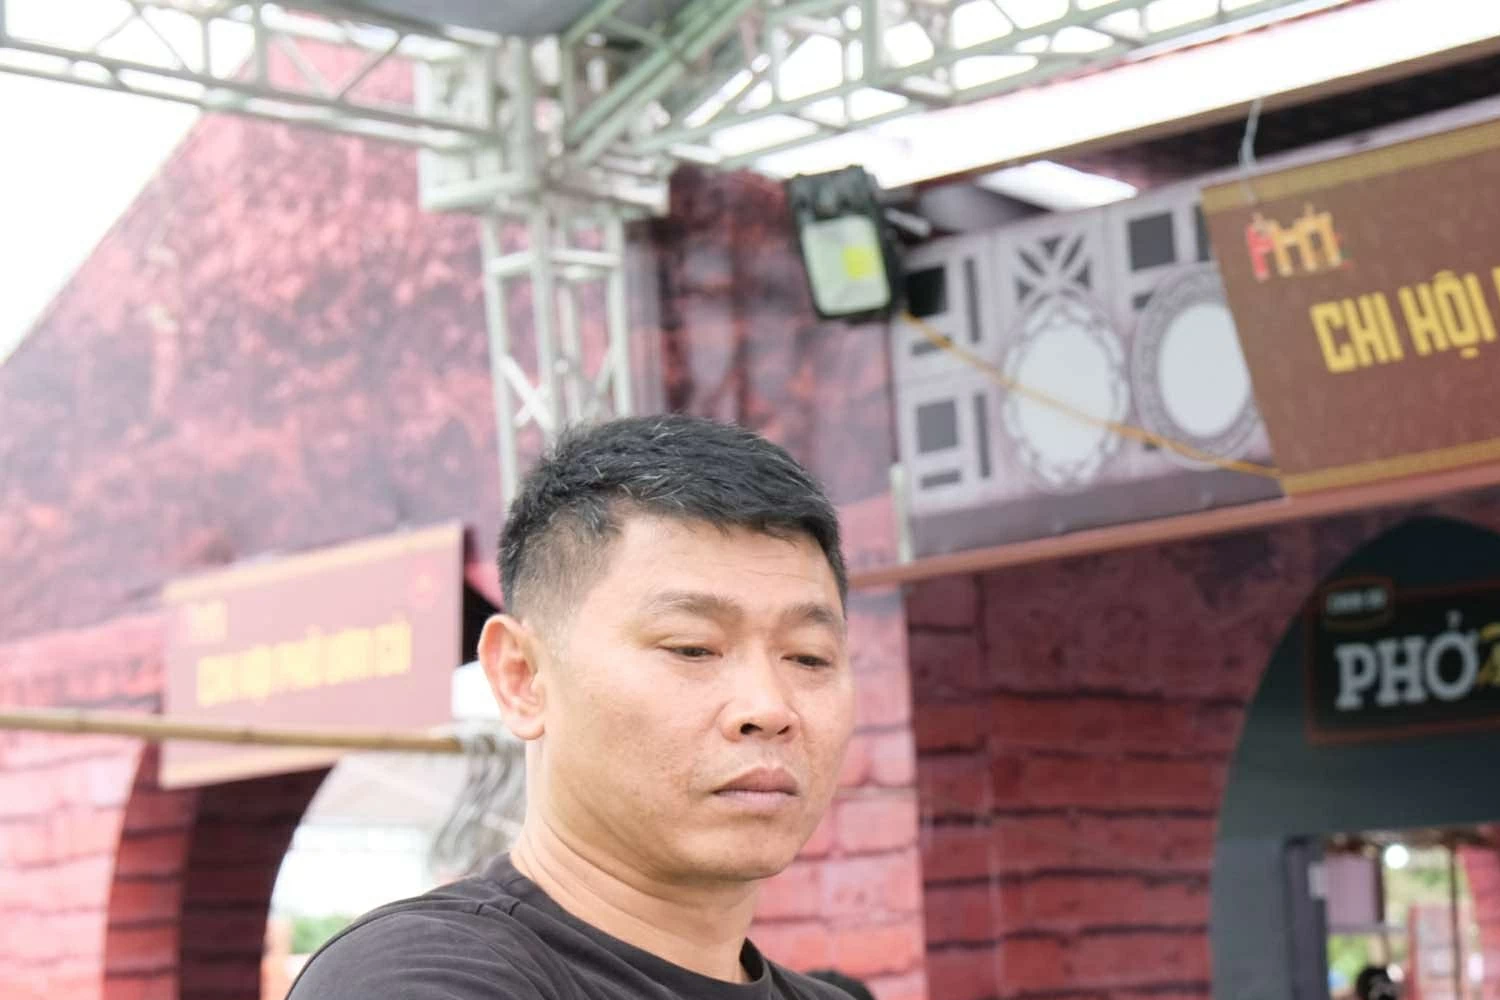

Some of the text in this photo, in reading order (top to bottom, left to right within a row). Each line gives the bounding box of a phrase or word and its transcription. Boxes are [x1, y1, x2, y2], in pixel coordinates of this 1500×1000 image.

[1309, 290, 1404, 374] CHI
[1397, 269, 1496, 360] HỘI
[1333, 609, 1479, 711] PHỞ
